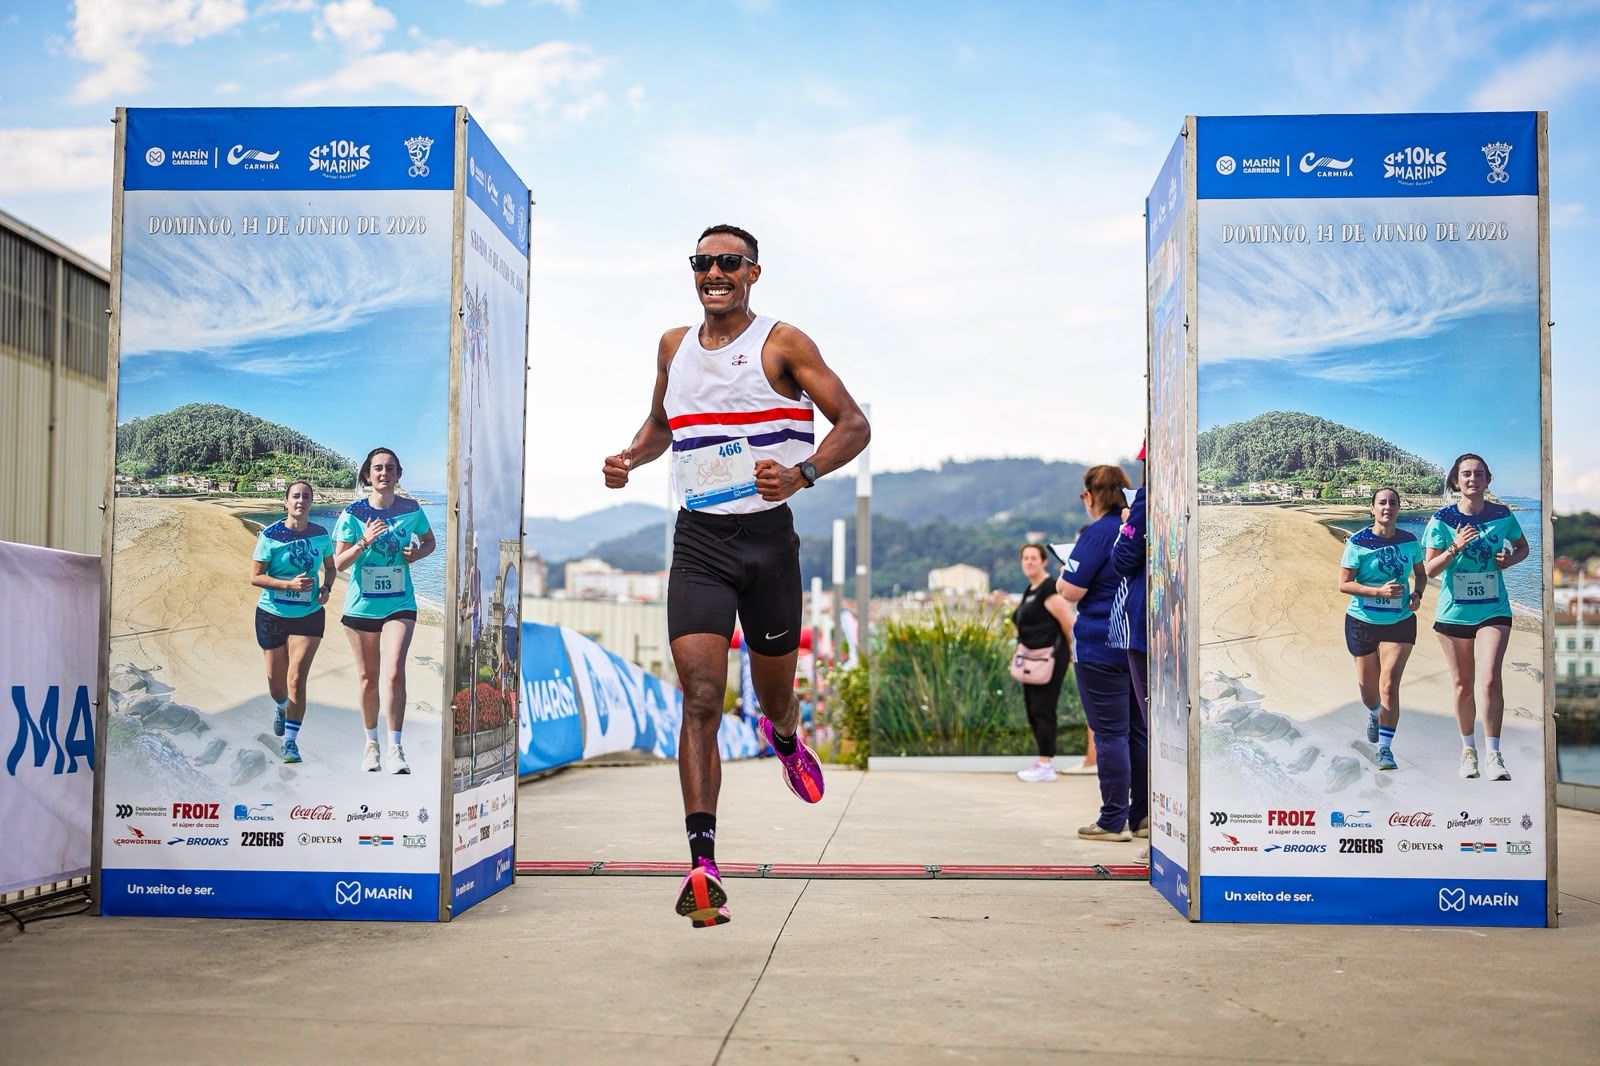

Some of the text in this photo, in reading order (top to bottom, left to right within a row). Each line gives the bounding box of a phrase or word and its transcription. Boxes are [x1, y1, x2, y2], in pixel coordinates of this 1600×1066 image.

[172, 149, 208, 159] MARÍN
[320, 156, 360, 173] MARÍN
[1242, 157, 1280, 167] MARÍN
[1395, 164, 1436, 180] MARÍN
[149, 216, 426, 237] DOMINGO, 14 DE JUNIO DE 2026
[1221, 222, 1508, 244] DOMINGO, 14 DE JUNIO DE 2026
[719, 442, 742, 457] 466
[375, 580, 391, 590] 513
[1467, 586, 1484, 596] 513
[6, 685, 95, 776] MA
[172, 803, 220, 819] FROIZ
[290, 804, 334, 820] Coca-Cola
[347, 811, 382, 822] Dromedario
[1268, 810, 1316, 827] FROIZ
[1389, 812, 1434, 827] Coca-Cola
[1447, 817, 1483, 829] Dromedario
[186, 838, 229, 846] BROOKS
[241, 832, 284, 847] 226ERS
[1339, 839, 1384, 854] 226ERS
[1283, 844, 1327, 853] BROOKS
[128, 884, 215, 895] Un xeito de ser.
[364, 886, 412, 900] MARÍN
[1224, 891, 1314, 902] Un xeito de ser.
[1469, 892, 1519, 906] MARÍN
